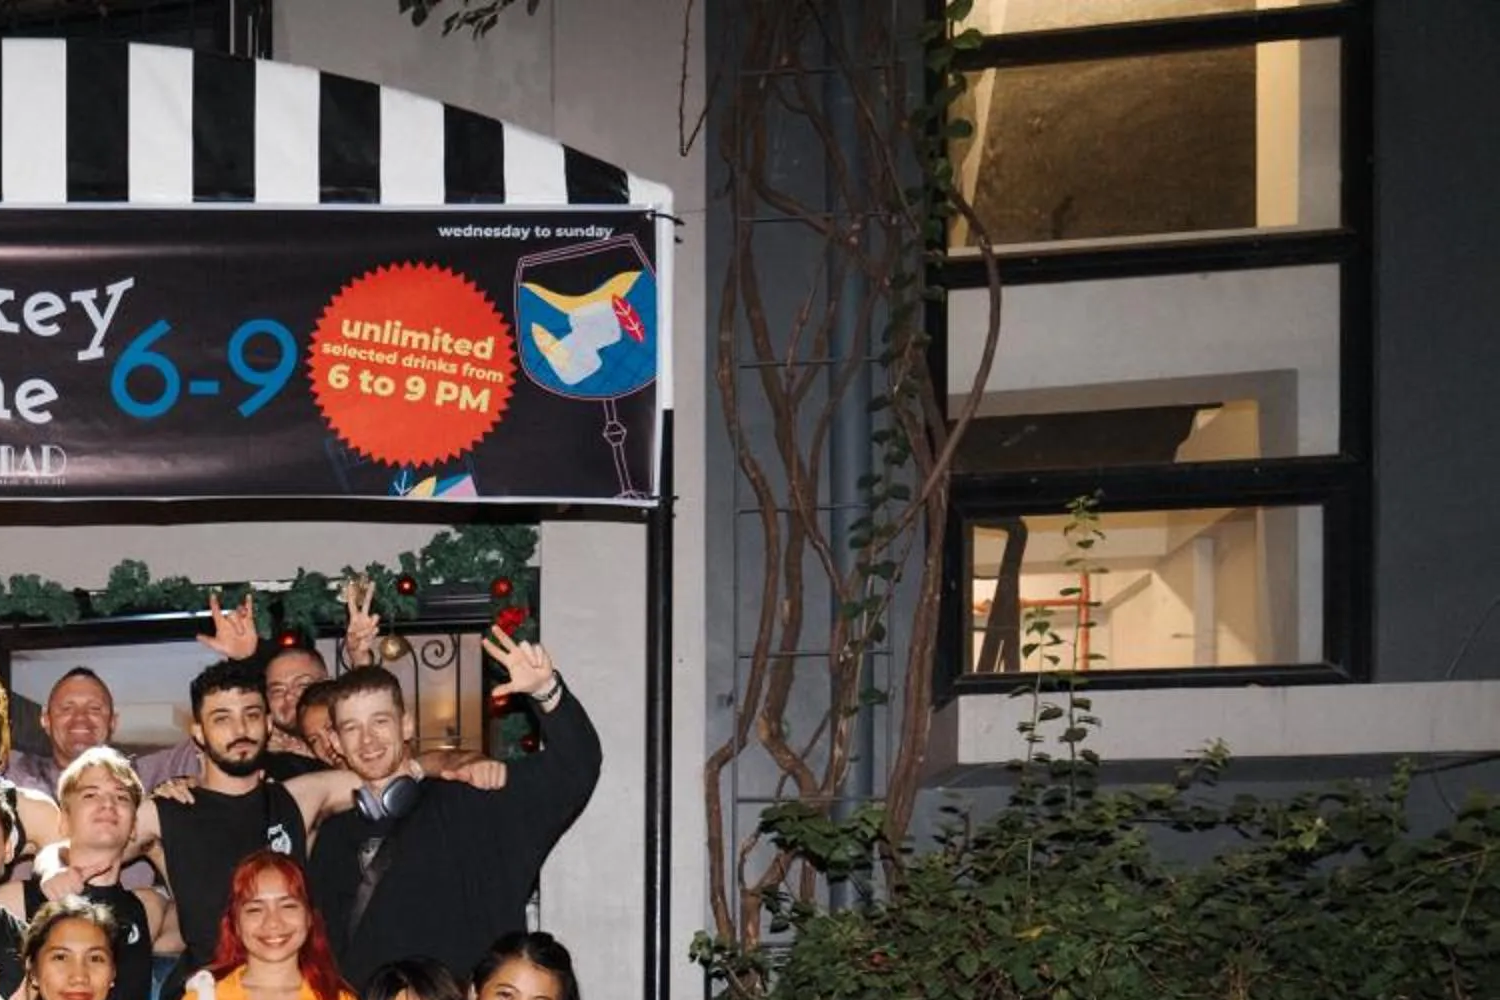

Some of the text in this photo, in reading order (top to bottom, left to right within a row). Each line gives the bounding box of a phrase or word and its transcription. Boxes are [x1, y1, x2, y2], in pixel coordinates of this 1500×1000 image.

[437, 224, 614, 241] wednesday to sunday
[341, 319, 494, 360] unlimited
[110, 318, 297, 418] 6-9
[321, 341, 504, 383] selected drinks from
[327, 363, 491, 413] 6 to 9 PM
